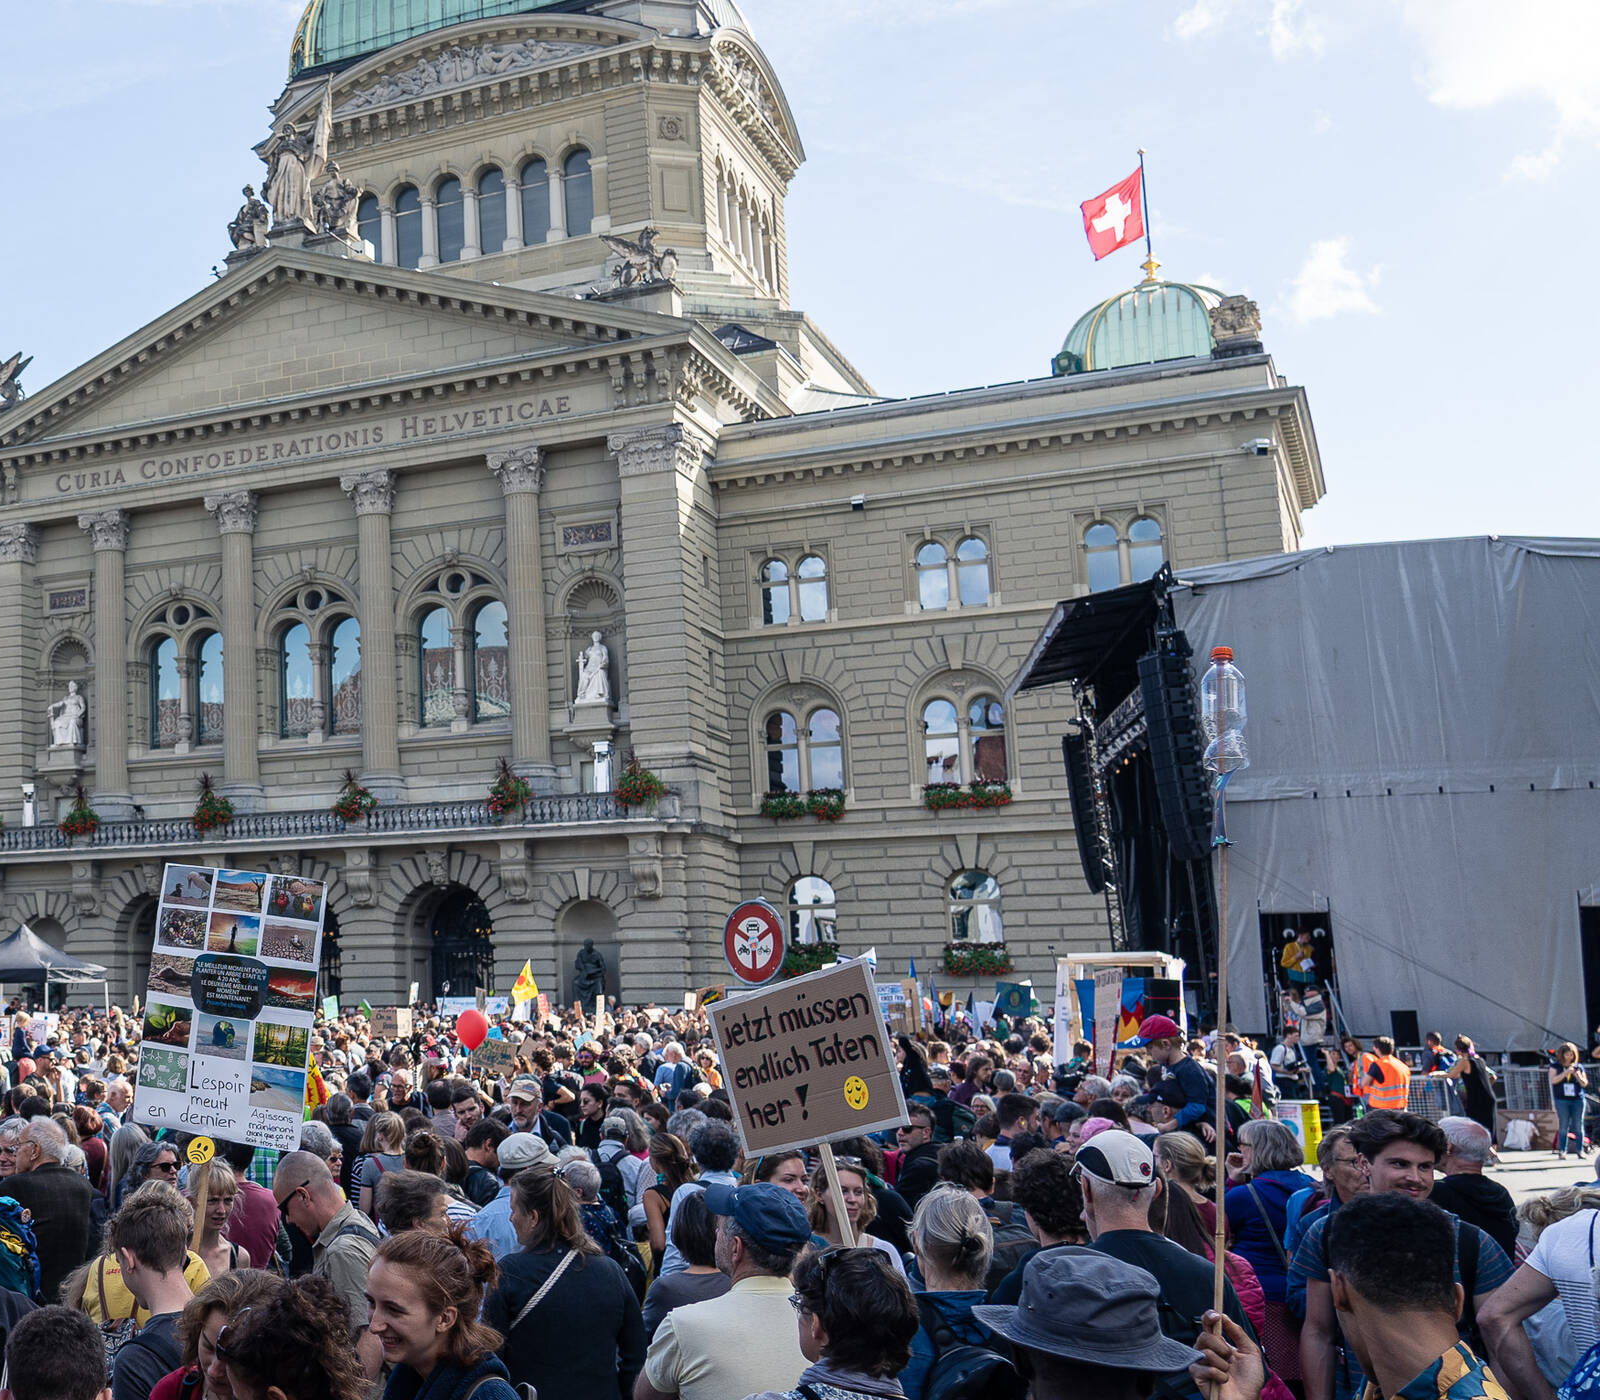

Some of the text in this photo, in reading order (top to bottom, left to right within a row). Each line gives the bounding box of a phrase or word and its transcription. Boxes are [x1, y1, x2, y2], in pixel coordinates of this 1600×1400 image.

[195, 966, 217, 975] PLANTER
[225, 970, 242, 978] ARBRE
[204, 962, 228, 970] MEILLEUR
[228, 965, 252, 973] MOMENT
[251, 967, 267, 975] POUR
[216, 987, 240, 995] MOMENT
[233, 983, 259, 992] MEILLEUR
[722, 992, 870, 1050] jetzt müssen
[734, 1033, 879, 1089] endlich Taten
[190, 1060, 247, 1095] L'espoir
[190, 1095, 228, 1110] meurt
[148, 1104, 236, 1128] en dernier
[250, 1108, 294, 1124] Agissons
[248, 1122, 294, 1133] maintenant
